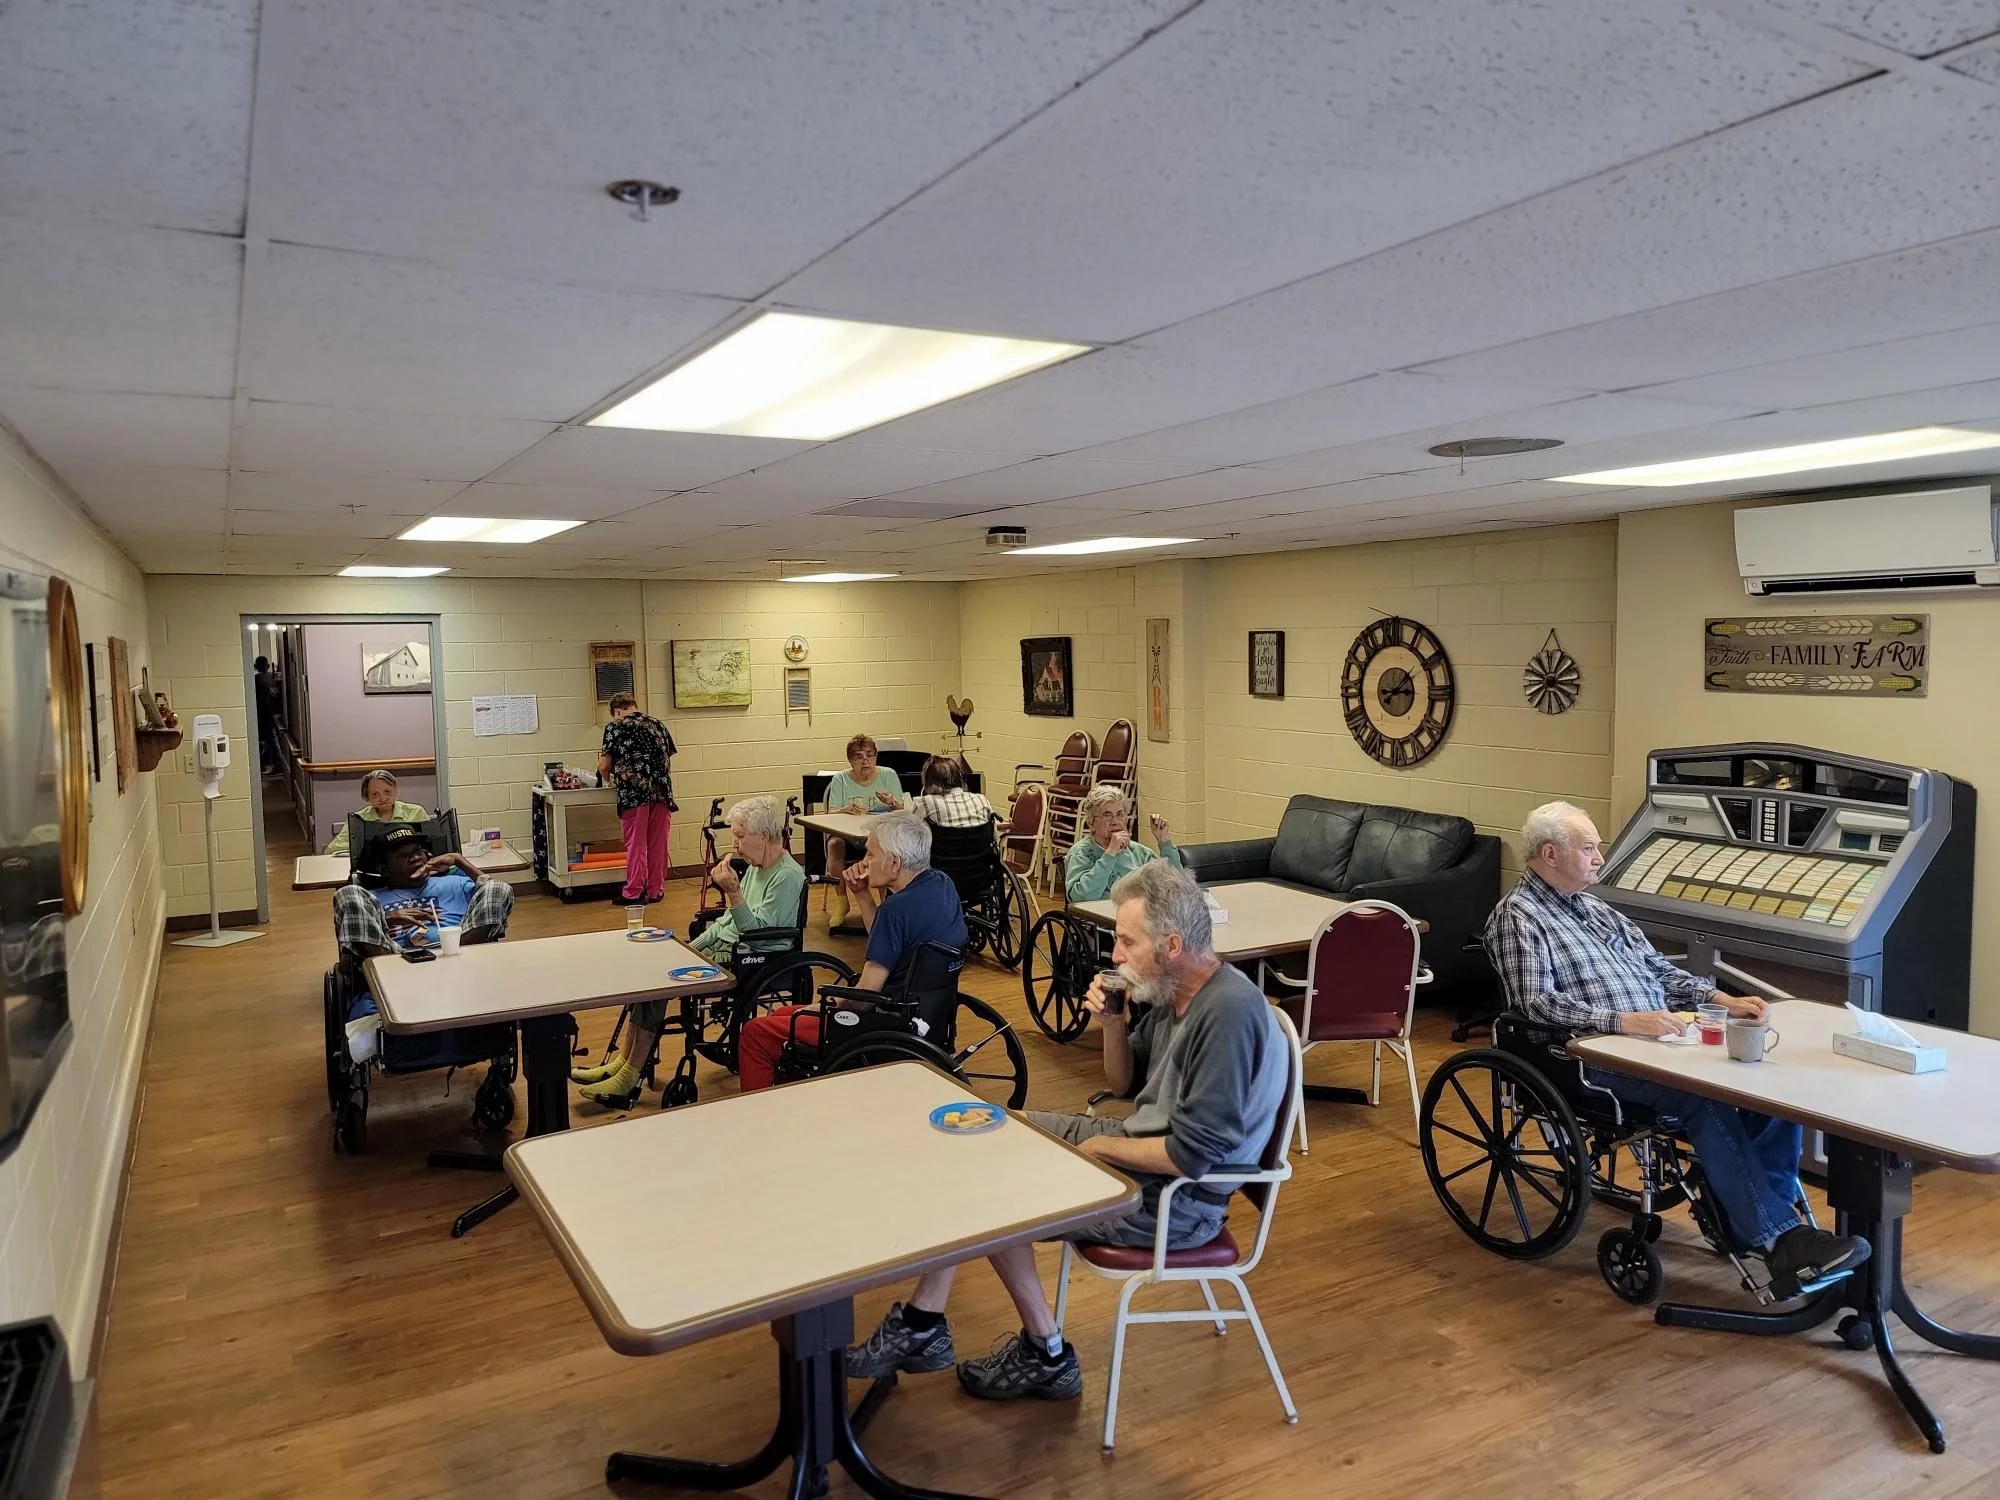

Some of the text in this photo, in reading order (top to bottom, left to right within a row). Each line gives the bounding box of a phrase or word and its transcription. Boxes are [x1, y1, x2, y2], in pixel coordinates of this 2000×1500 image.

[1770, 644, 1847, 666] FAMILY
[1850, 638, 1927, 672] FARM
[386, 828, 414, 841] HUSTLE
[741, 955, 766, 965] drive
